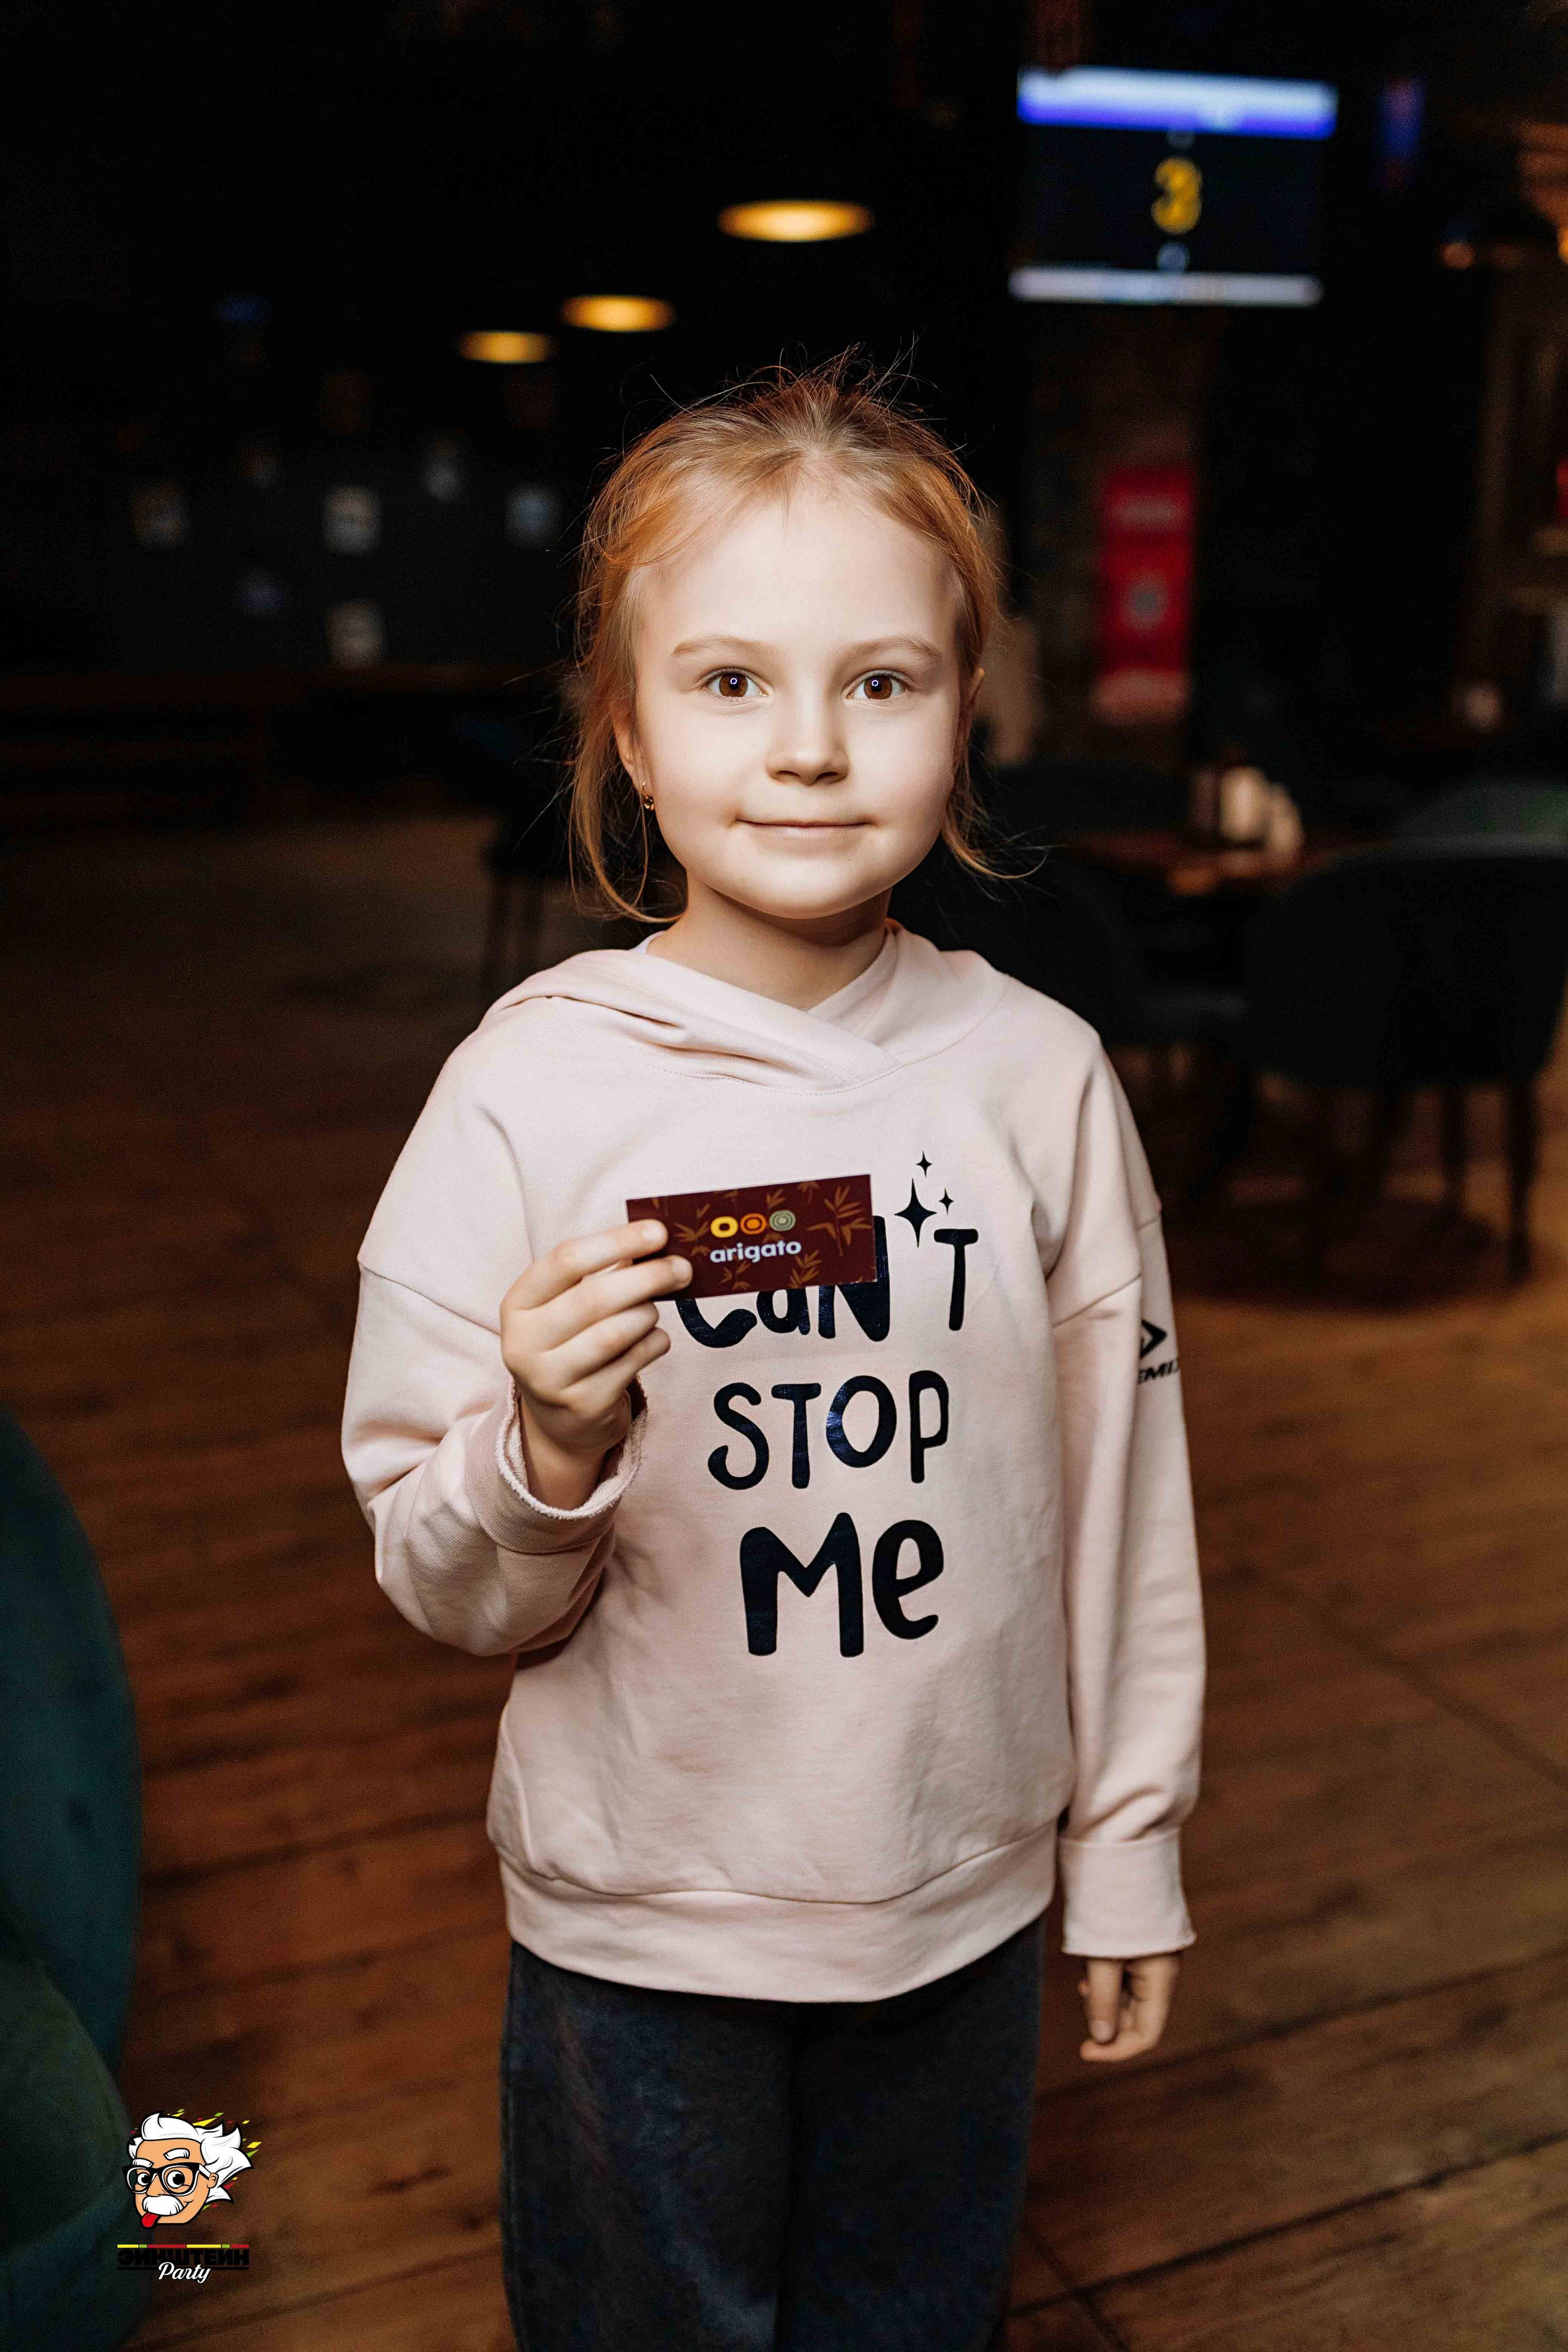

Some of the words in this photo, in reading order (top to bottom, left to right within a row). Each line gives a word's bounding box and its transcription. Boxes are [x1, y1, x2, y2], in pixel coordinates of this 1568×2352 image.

[1152, 156, 1202, 235] 3
[709, 1240, 802, 1263] arigato
[707, 1370, 949, 1490] STOP
[739, 1512, 944, 1657] Me
